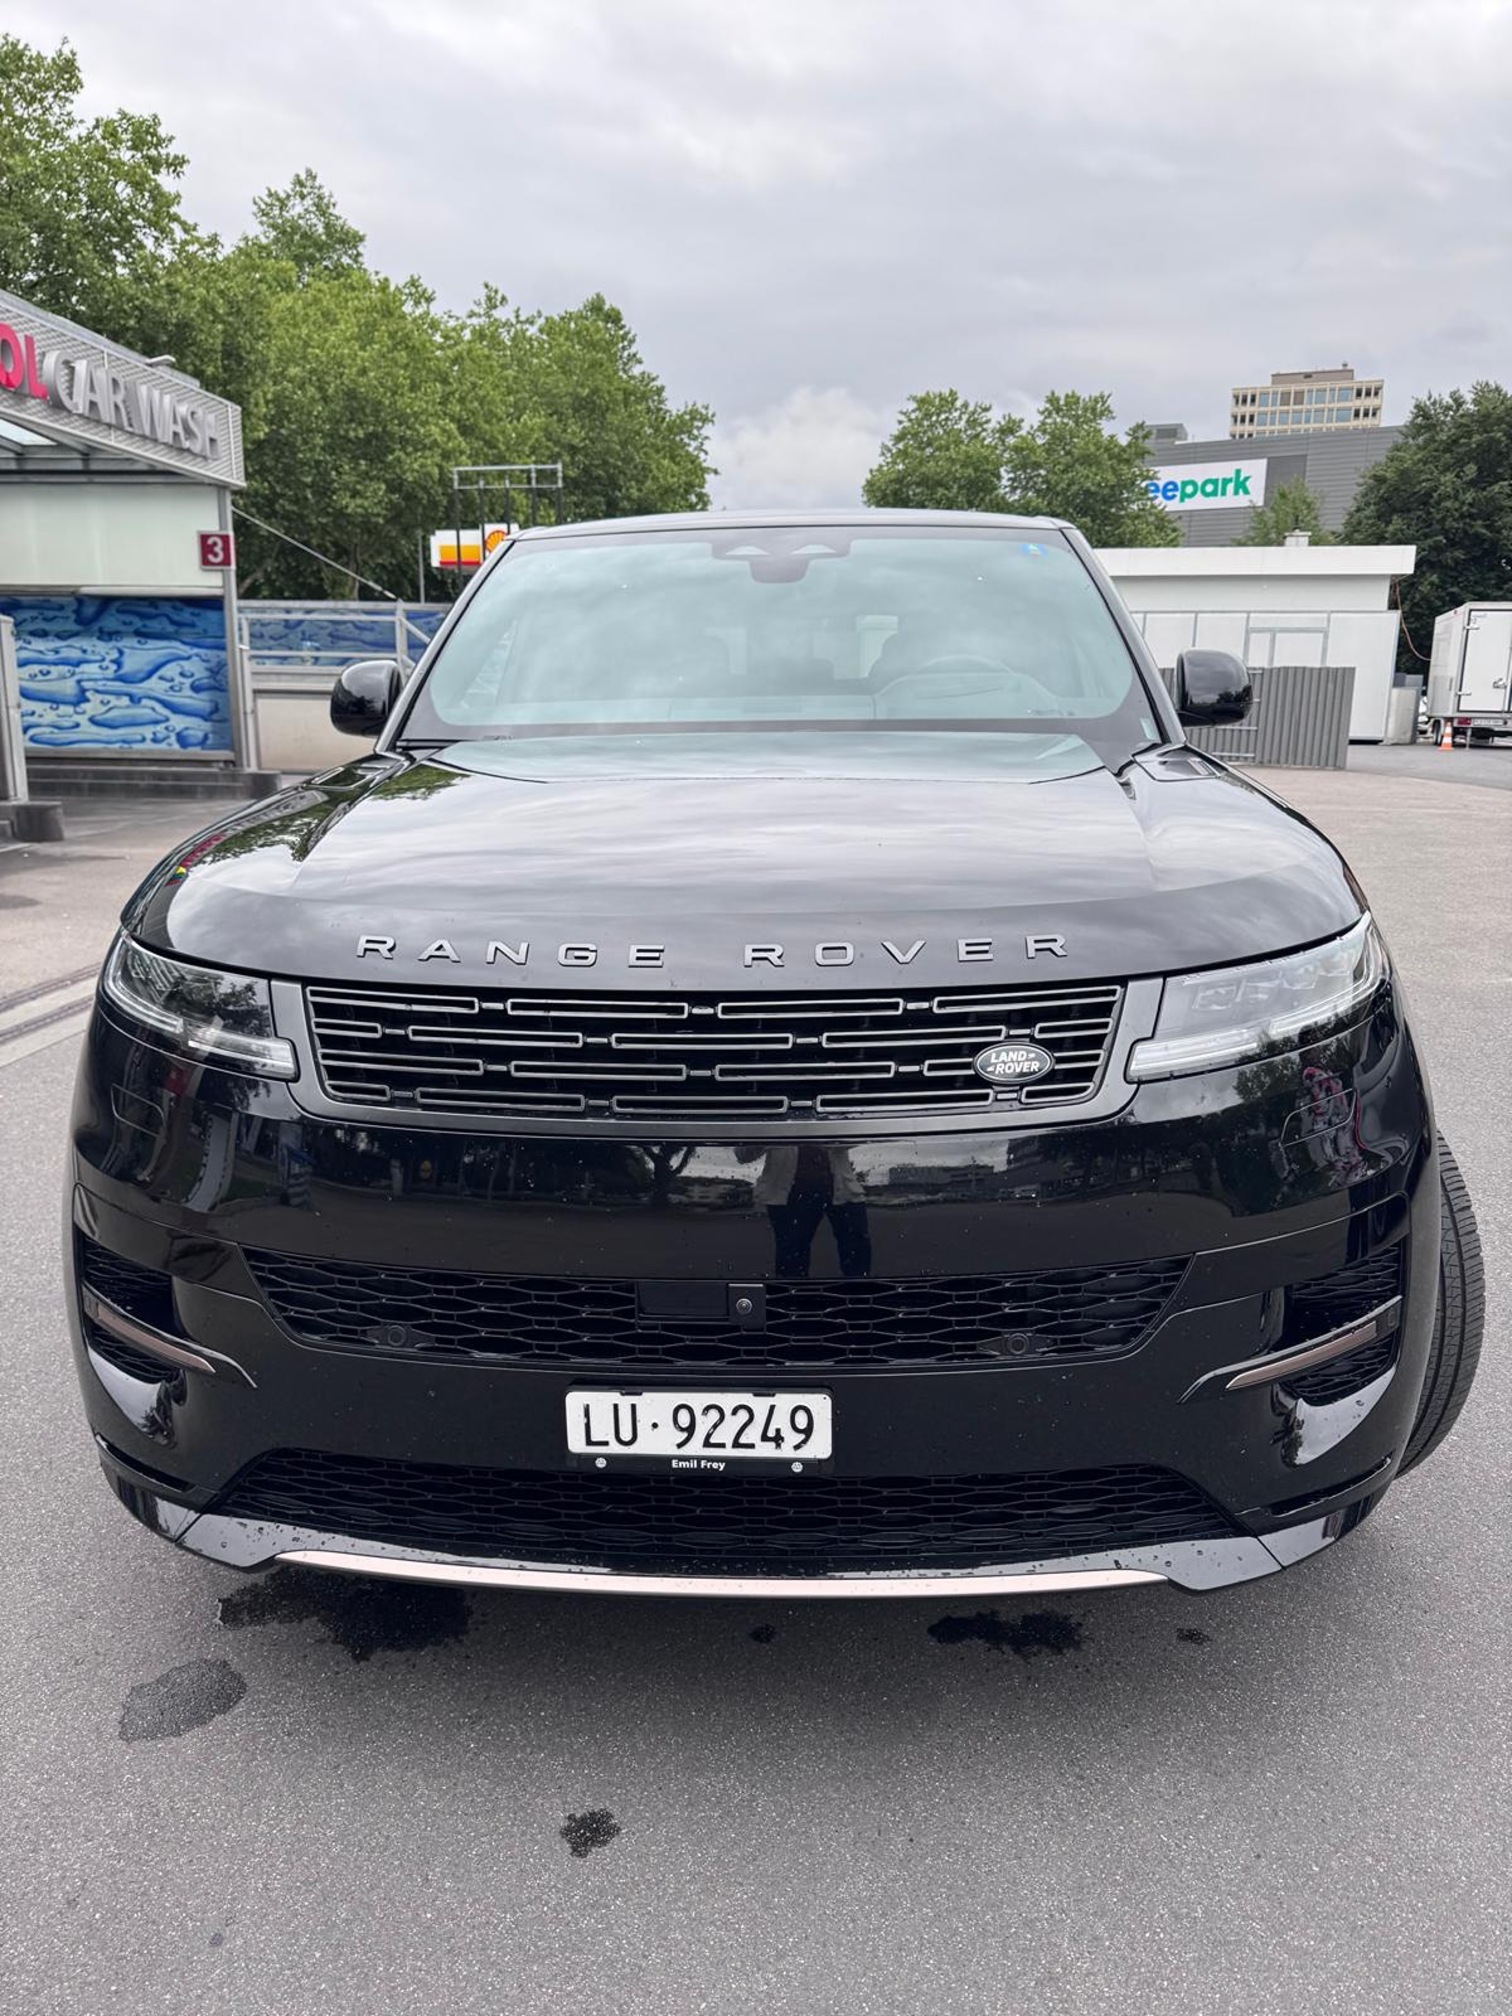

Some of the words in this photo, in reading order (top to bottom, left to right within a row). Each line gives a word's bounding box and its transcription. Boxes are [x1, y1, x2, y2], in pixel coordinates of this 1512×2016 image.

[43, 351, 135, 431] CAR
[125, 379, 221, 460] WASH
[207, 536, 224, 563] 3
[356, 935, 665, 968] RANGE
[744, 934, 1068, 967] ROVER
[990, 1050, 1028, 1063] LAND
[995, 1061, 1040, 1074] ROVER
[671, 1459, 697, 1469] Emil
[700, 1460, 726, 1471] Frey
